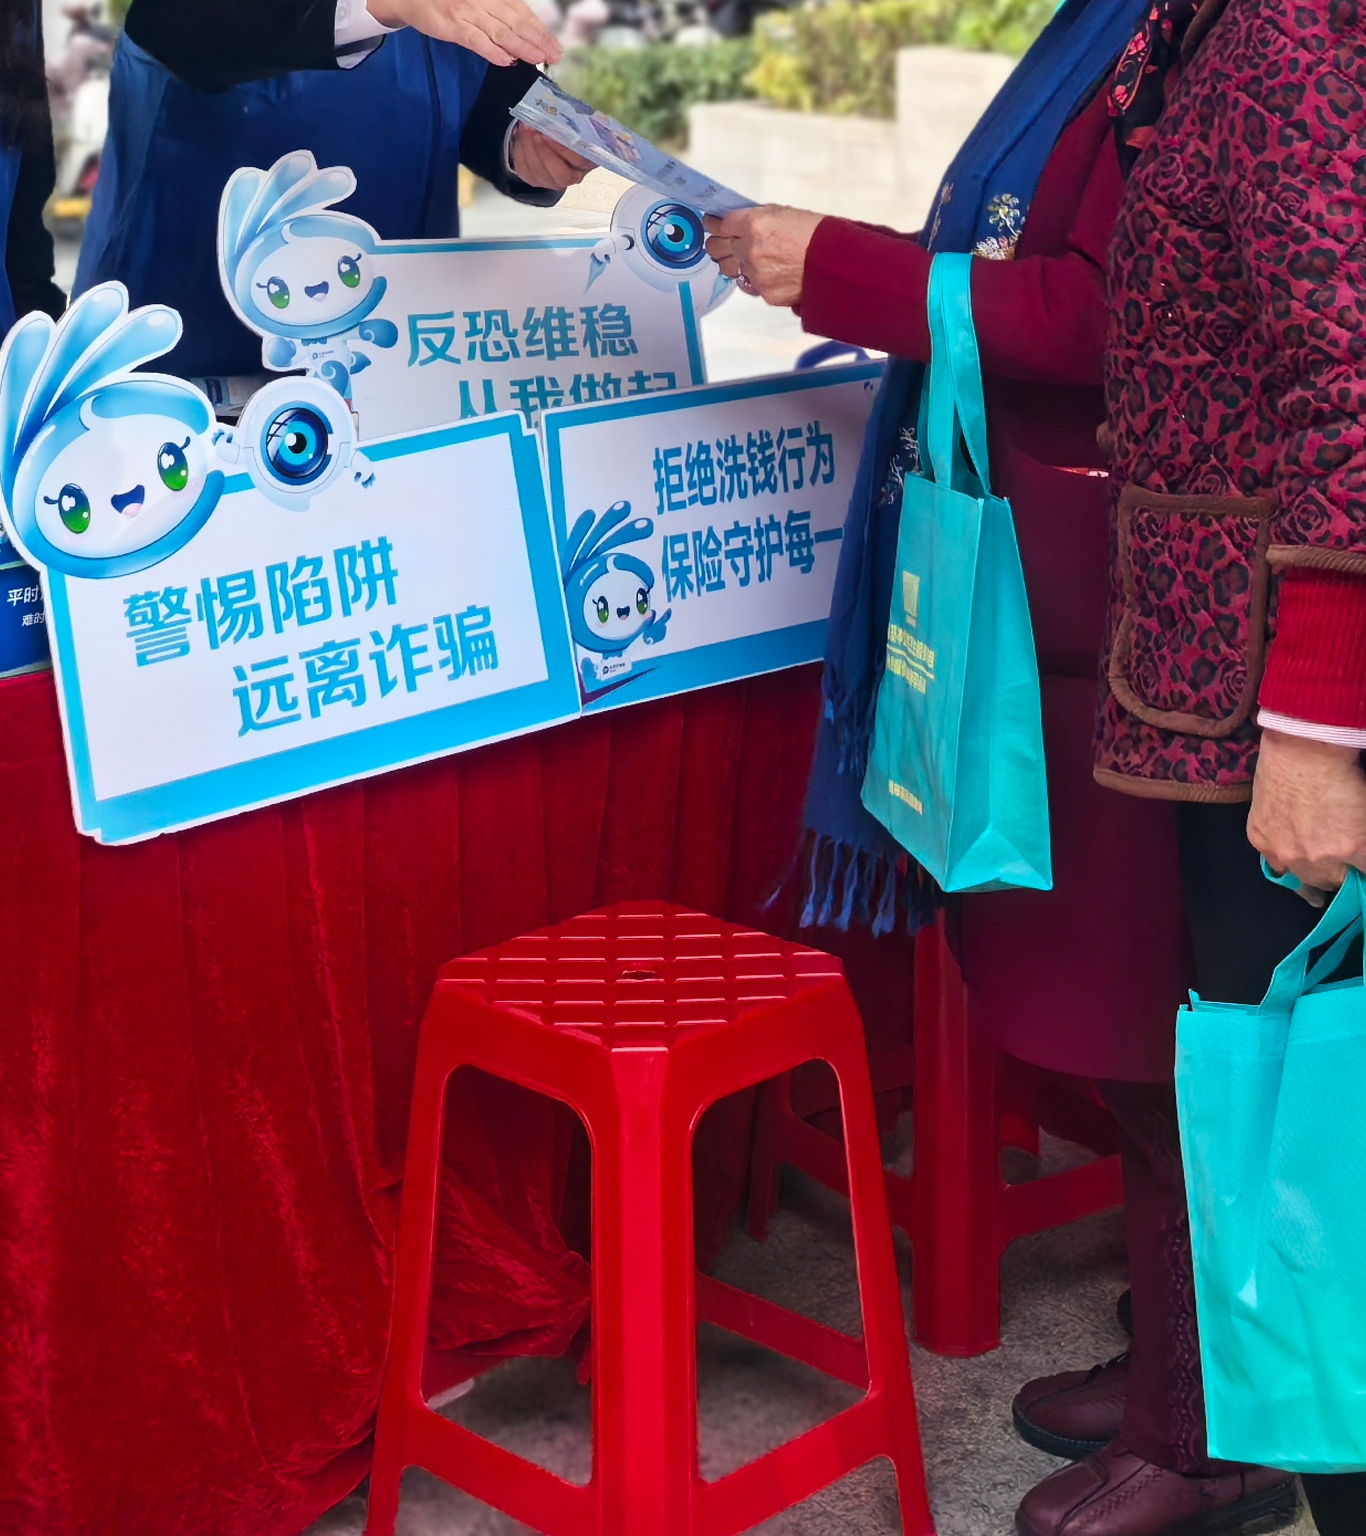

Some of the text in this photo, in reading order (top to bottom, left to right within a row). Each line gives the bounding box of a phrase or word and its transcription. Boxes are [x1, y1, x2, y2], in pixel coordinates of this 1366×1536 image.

[407, 302, 638, 368] 反恐维稳
[653, 420, 835, 516] 拒绝洗钱行为
[7, 587, 44, 607] 平时
[122, 535, 399, 668] 警惕陷阱
[662, 509, 844, 603] 保险守护每一
[231, 604, 499, 738] 远离诈骗
